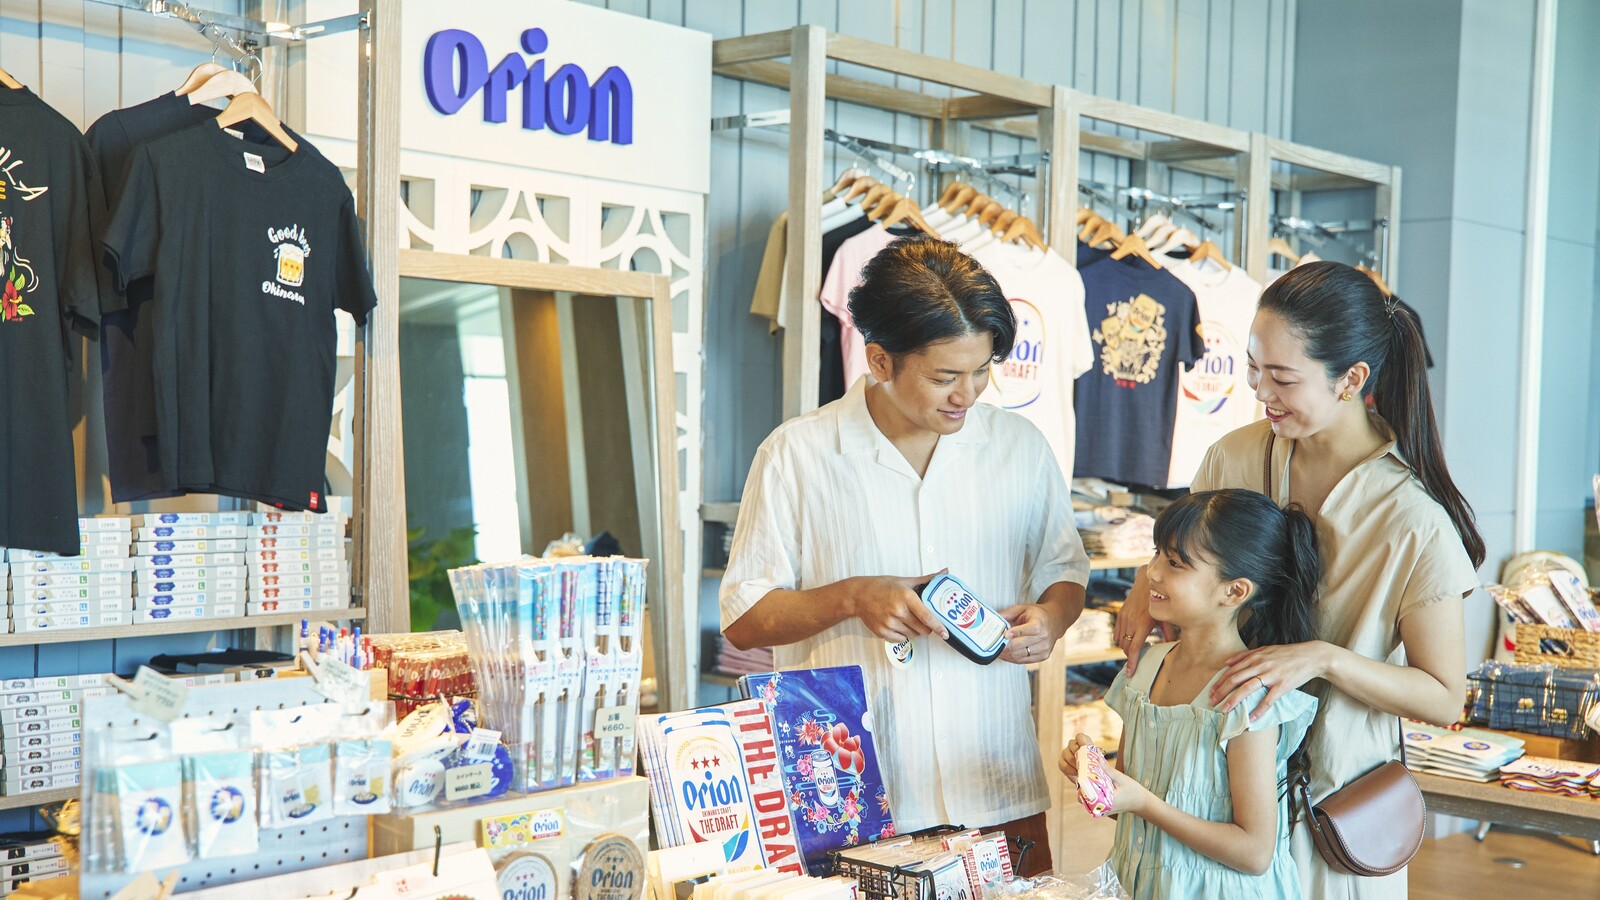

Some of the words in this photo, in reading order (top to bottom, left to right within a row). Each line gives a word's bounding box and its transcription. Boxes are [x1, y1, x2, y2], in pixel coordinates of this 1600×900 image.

[424, 28, 632, 145] Orion
[267, 223, 298, 244] Good
[947, 593, 973, 620] Orion
[602, 723, 625, 732] ¥660
[739, 715, 777, 785] THE
[409, 779, 435, 796] Orion
[817, 775, 835, 786] Orion
[682, 771, 743, 811] Orion
[721, 807, 732, 815] CRAFT
[533, 819, 559, 832] Orion
[699, 819, 715, 834] THE
[715, 814, 739, 832] DRAFT
[997, 837, 1009, 861] THE
[980, 857, 998, 871] Orion
[592, 864, 633, 888] Orion
